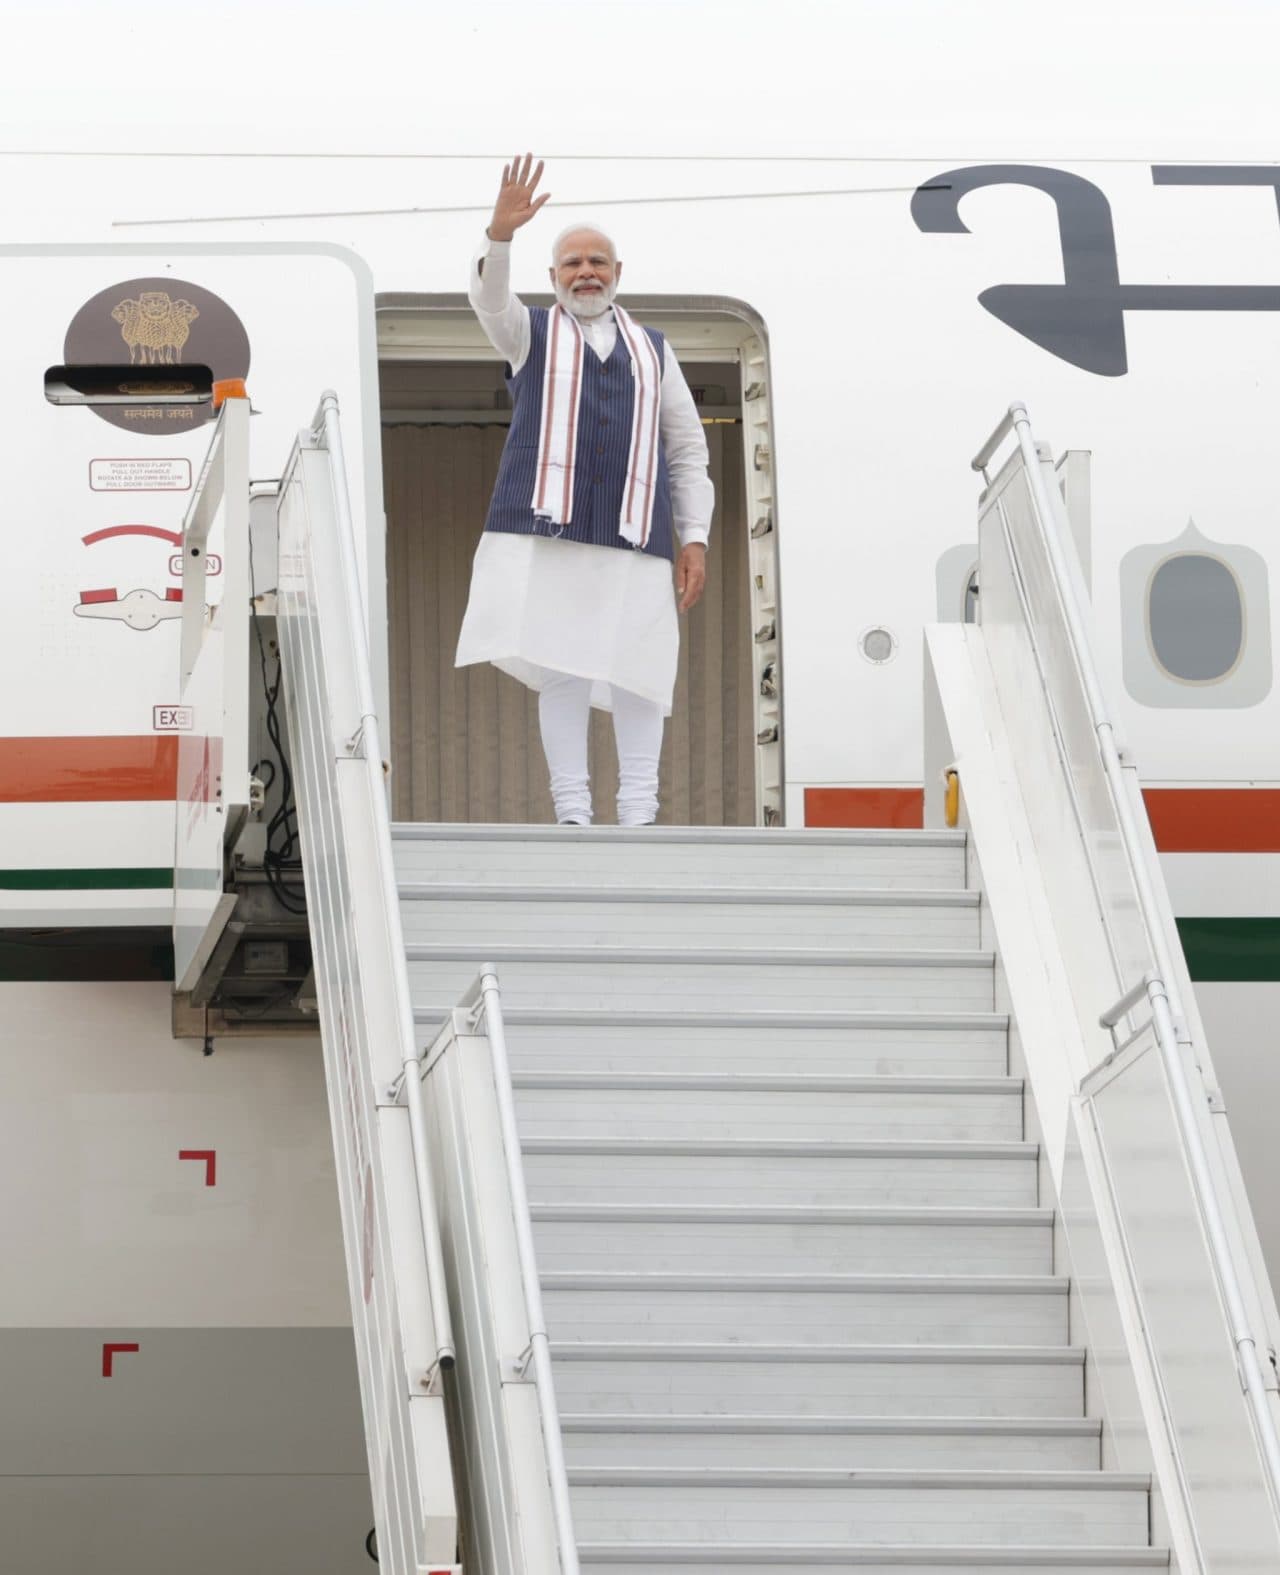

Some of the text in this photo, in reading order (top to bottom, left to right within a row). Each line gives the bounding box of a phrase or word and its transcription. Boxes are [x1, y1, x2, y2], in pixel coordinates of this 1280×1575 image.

[123, 405, 193, 420] सत्यमेव जयते
[174, 559, 216, 571] ON
